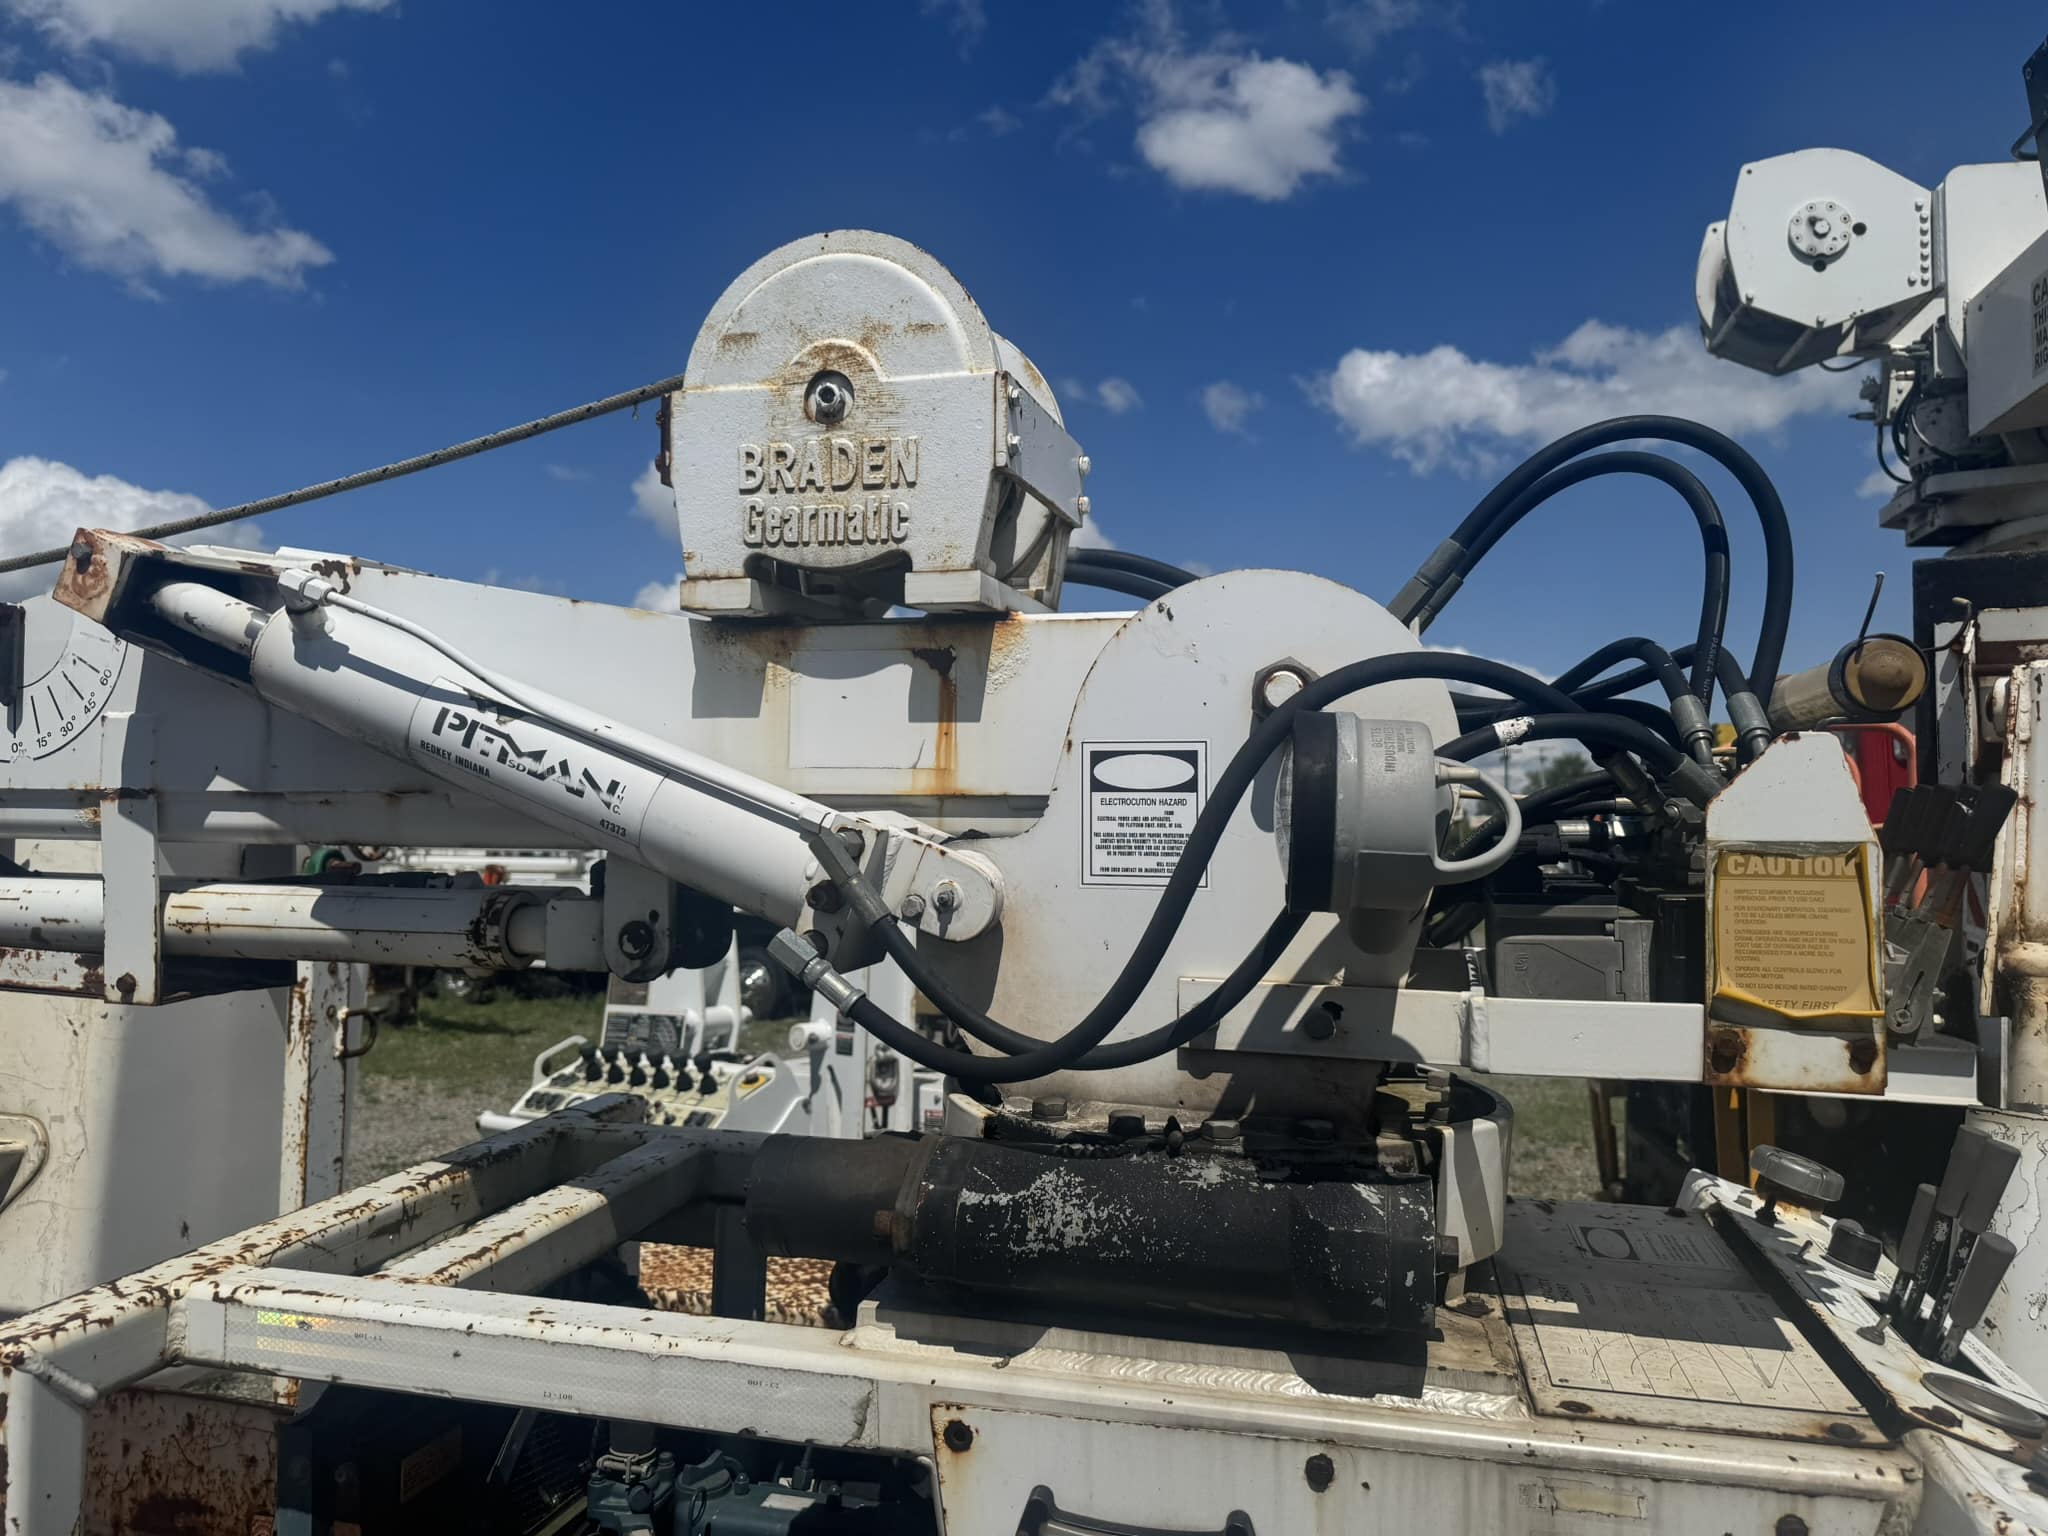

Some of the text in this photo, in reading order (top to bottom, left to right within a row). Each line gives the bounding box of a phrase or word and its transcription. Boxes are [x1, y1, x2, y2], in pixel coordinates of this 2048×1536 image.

[738, 435, 920, 495] BRADEN
[743, 495, 912, 548] Gearmatic
[99, 668, 112, 686] 60
[83, 691, 97, 715] 45°
[60, 715, 76, 737] 30°
[11, 741, 23, 753] 0°
[36, 731, 52, 748] 15°
[420, 739, 491, 779] REDKEY INDIANA
[1100, 798, 1156, 806] ELECTROCUTION
[599, 818, 627, 838] 47373
[1727, 854, 1857, 877] CAUTION
[1762, 999, 1840, 1010] FETY FIRST
